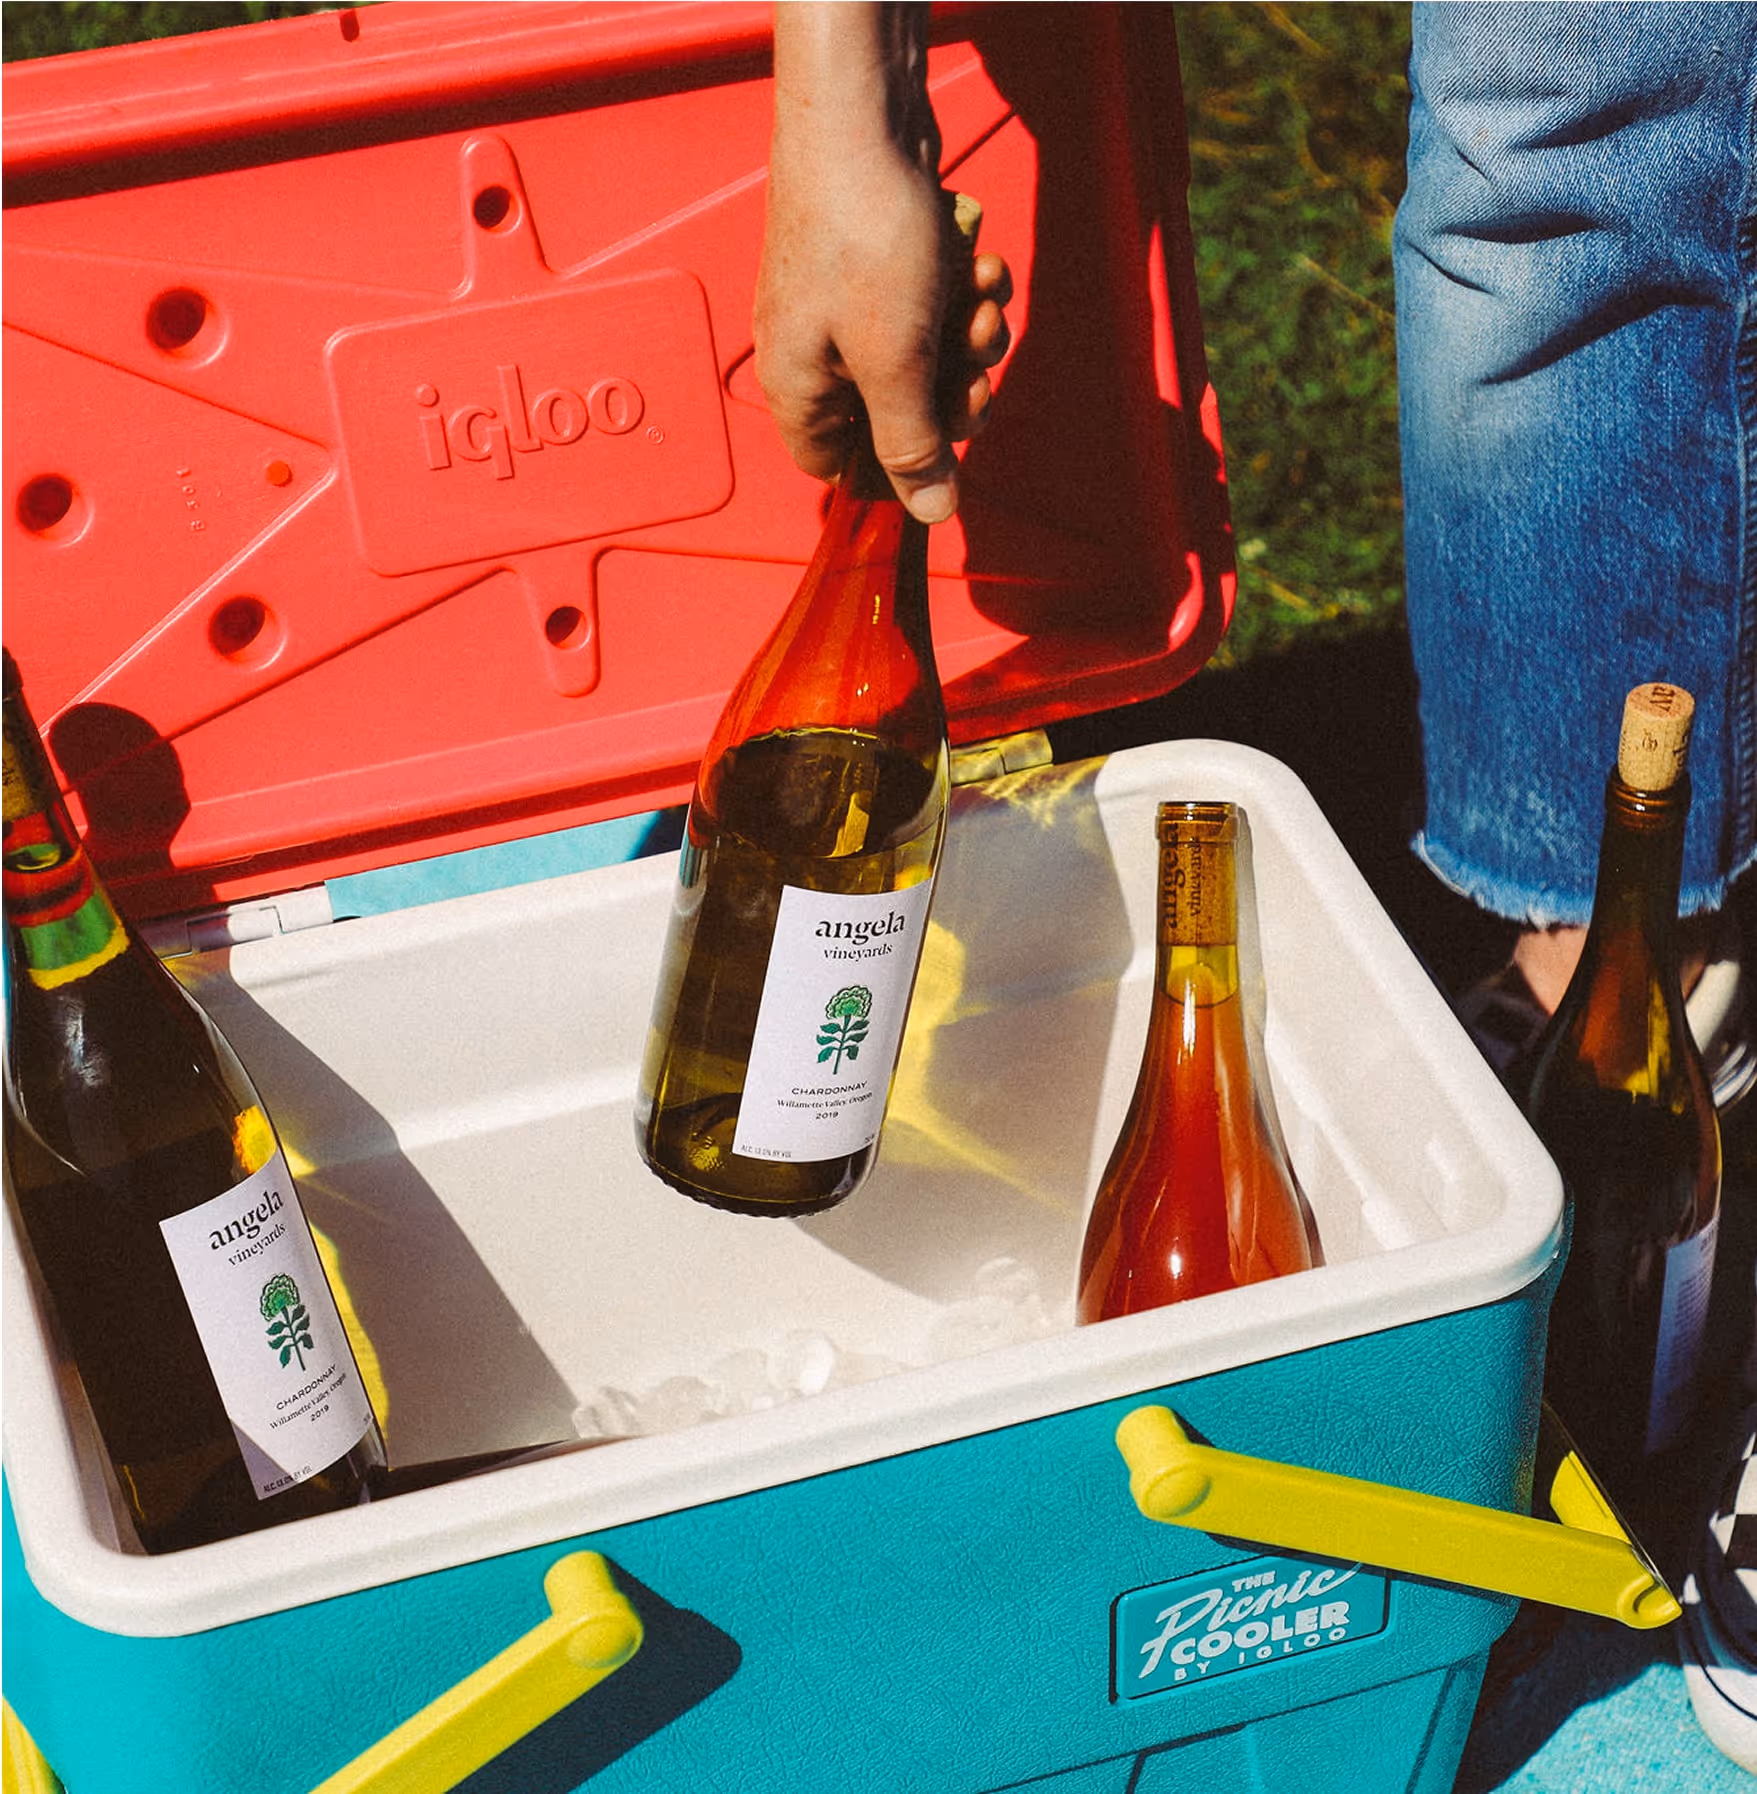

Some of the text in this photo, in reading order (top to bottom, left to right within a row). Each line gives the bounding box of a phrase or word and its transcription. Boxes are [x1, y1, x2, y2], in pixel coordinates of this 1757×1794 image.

[416, 364, 645, 481] igloo
[1161, 822, 1186, 929] angela
[815, 911, 905, 945] angela
[824, 943, 893, 962] vineyards
[777, 1098, 824, 1109] Willamette
[848, 1092, 873, 1105] Oregon
[791, 1080, 868, 1095] CHARDONNAY
[815, 1111, 839, 1120] 2019
[209, 1190, 284, 1250] angela
[228, 1223, 286, 1266] vineyards
[276, 1364, 336, 1411] CHARDONNAY
[269, 1402, 312, 1429] Willamette
[310, 1404, 330, 1422] 2019
[1232, 1570, 1276, 1592] THE
[1139, 1561, 1363, 1680] Picnic
[1170, 1601, 1350, 1665] COOLER
[1174, 1627, 1347, 1681] BY IGLOO
